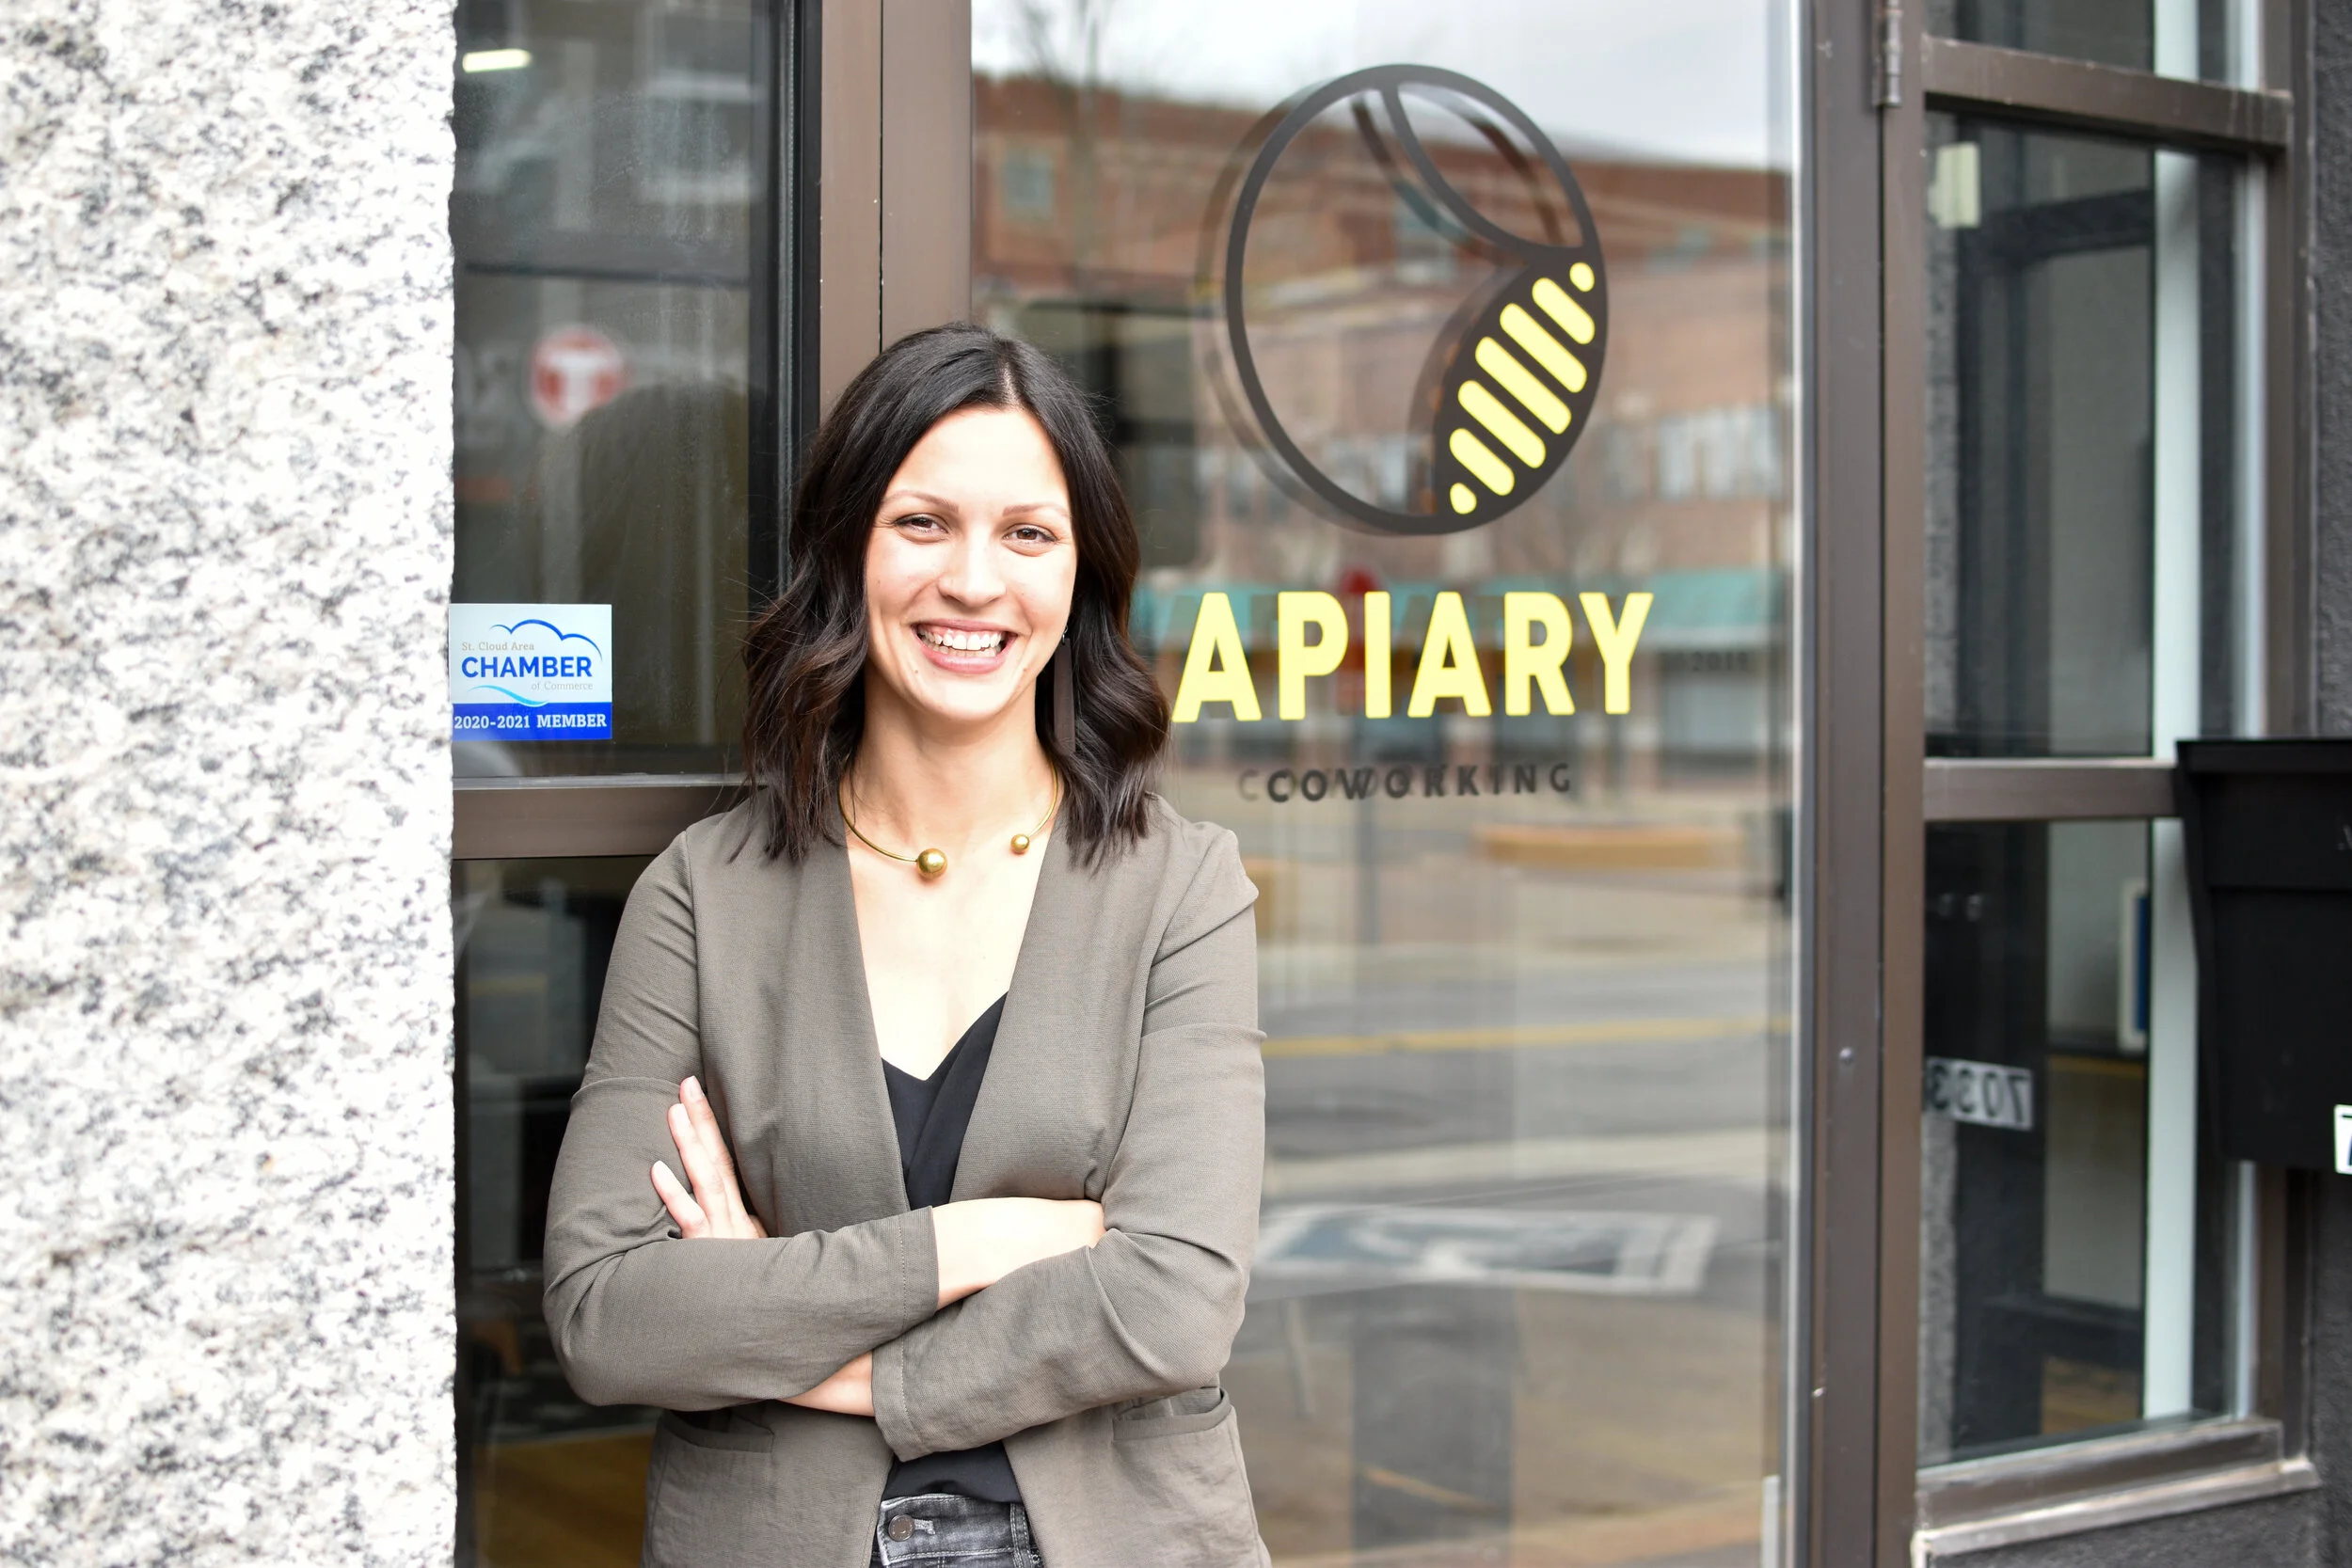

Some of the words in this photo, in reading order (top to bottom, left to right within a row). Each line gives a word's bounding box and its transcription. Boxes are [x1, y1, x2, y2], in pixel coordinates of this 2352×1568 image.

[461, 641, 475, 651] St.
[478, 641, 508, 651] Cloud
[511, 641, 534, 651] Area
[1171, 591, 1654, 723] APIARY
[461, 656, 593, 678] CHAMBER
[531, 680, 541, 690] of
[544, 680, 594, 690] Commerce
[453, 715, 531, 729] 2020-2021
[536, 713, 608, 728] MEMBER
[1266, 763, 1571, 803] COWORKING
